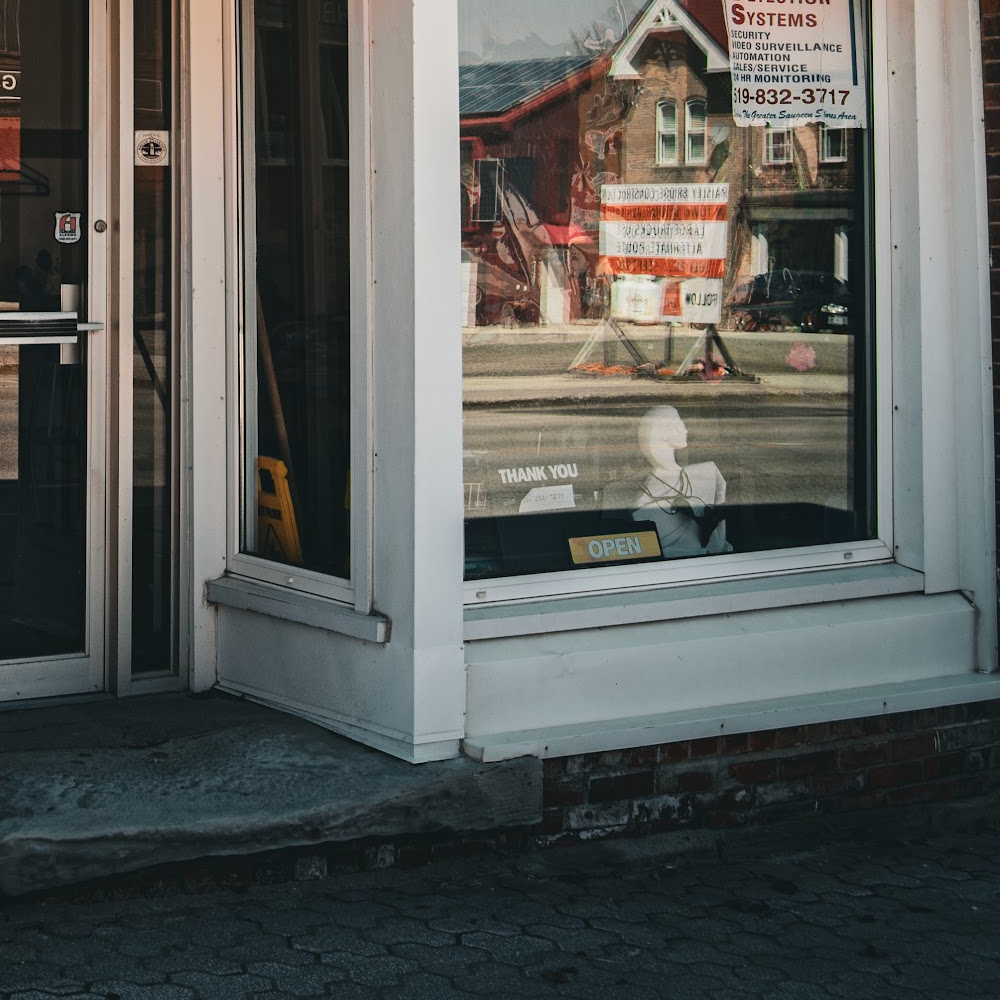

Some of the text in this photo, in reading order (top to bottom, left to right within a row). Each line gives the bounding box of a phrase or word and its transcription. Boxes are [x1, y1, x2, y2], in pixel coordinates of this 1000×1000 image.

[731, 3, 818, 28] SYSTEMS
[731, 29, 771, 40] SECURITY
[732, 41, 843, 53] VIDEO SURVEILLANCE
[733, 52, 791, 62] AUTOMATION
[740, 74, 751, 83] HR
[754, 73, 831, 83] MONITORING
[498, 463, 579, 484] THANK YOU
[588, 536, 642, 559] OPEN
